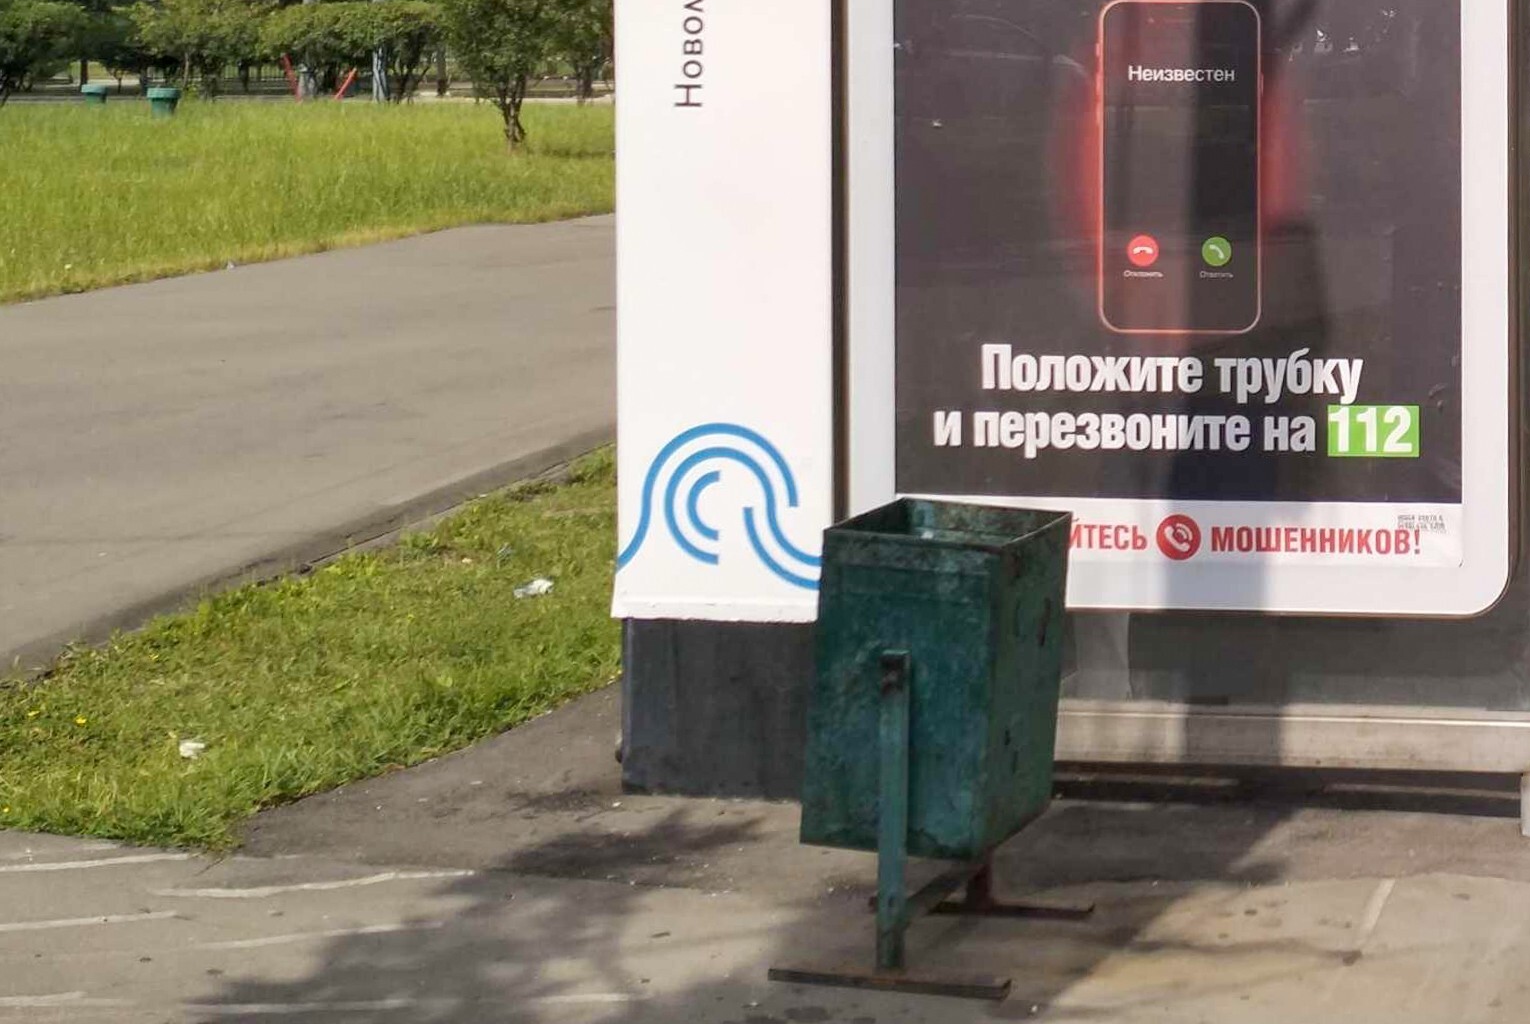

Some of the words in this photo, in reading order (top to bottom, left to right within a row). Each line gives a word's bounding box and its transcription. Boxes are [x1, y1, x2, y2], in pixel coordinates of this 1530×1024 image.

[1127, 65, 1235, 83] Неизвестен
[981, 343, 1203, 393] Положите
[1214, 348, 1364, 404] трубку
[933, 410, 962, 447] и
[973, 410, 1251, 459] перезвоните
[1264, 414, 1316, 453] на
[1328, 406, 1413, 454] 112
[1069, 517, 1148, 551] ЙТЕСЬ
[1210, 525, 1421, 555] МОШЕННИКОВ!
